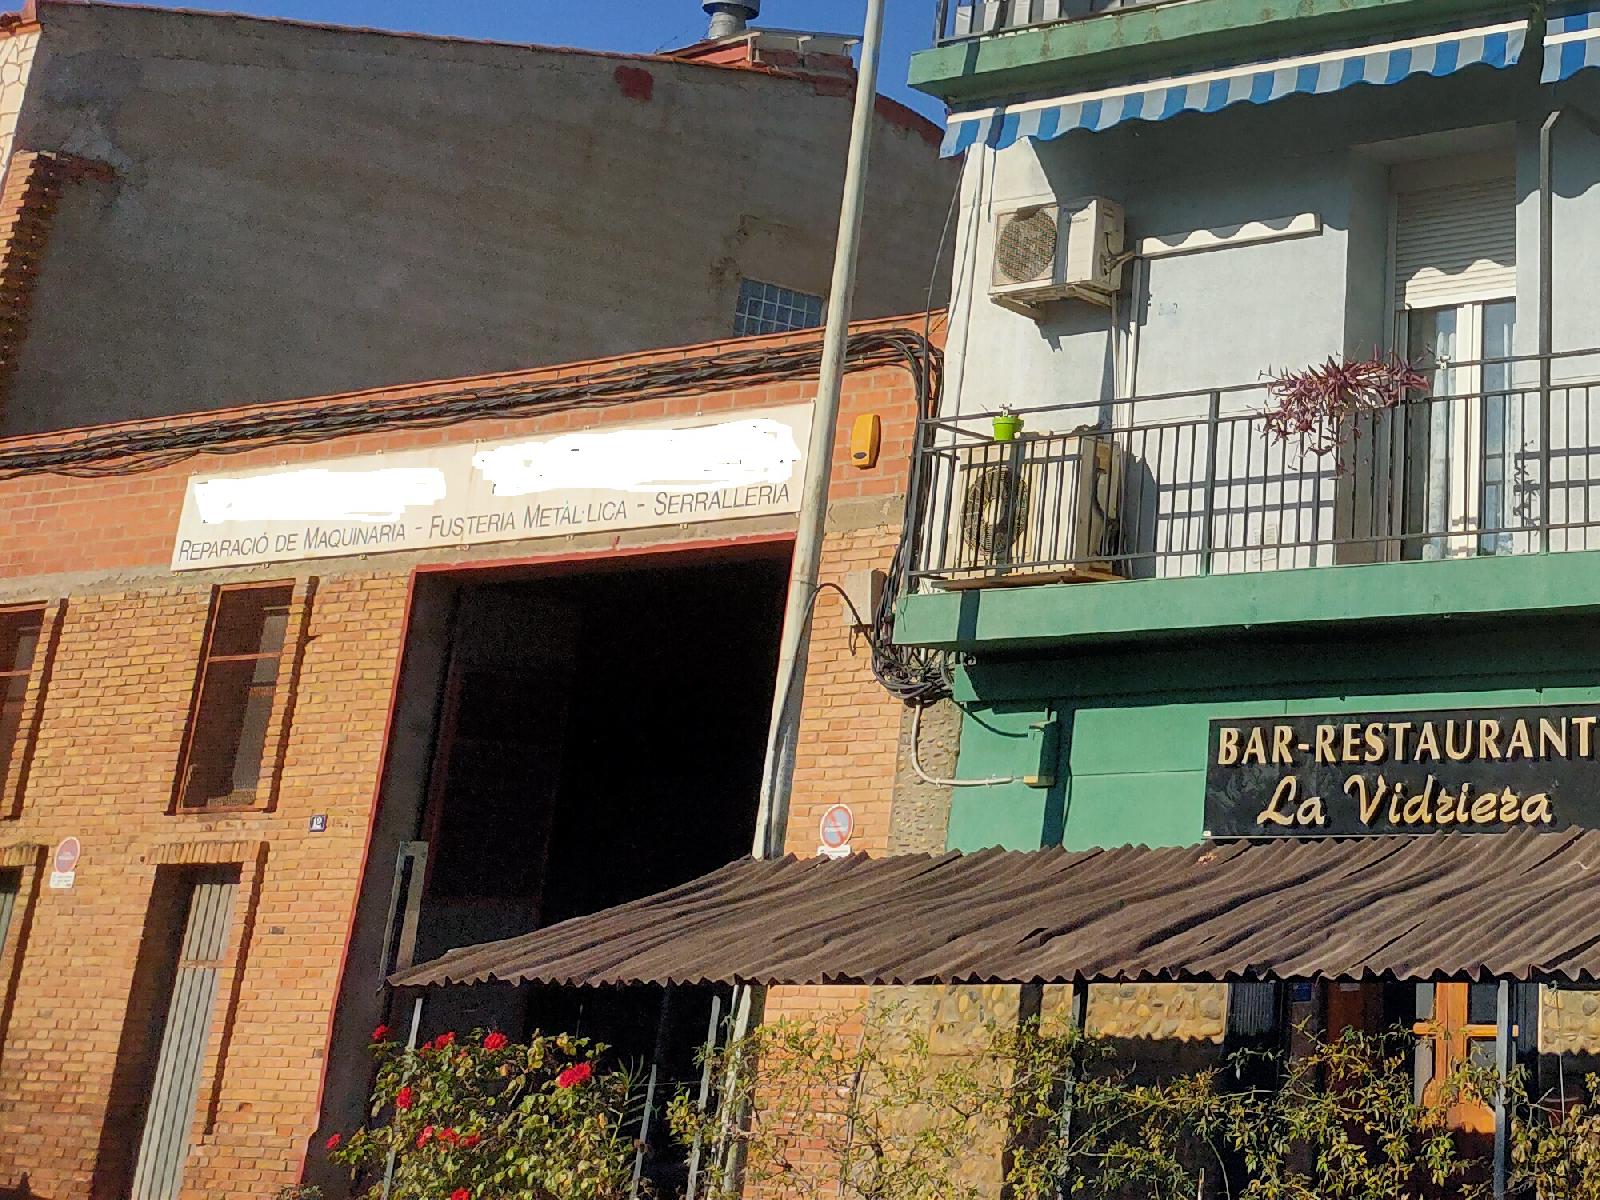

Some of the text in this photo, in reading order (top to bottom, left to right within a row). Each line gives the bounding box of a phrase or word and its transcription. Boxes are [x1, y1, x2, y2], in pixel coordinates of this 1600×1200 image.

[179, 532, 269, 562] REPARACIÓ
[275, 533, 298, 553] DE
[303, 524, 406, 550] MAQUINARIA
[429, 512, 515, 539] FUSTERIA
[654, 484, 789, 516] SERRALLERIA
[1218, 716, 1598, 765] BAR-RESTAURANT
[1256, 774, 1554, 826] La Vidriera
